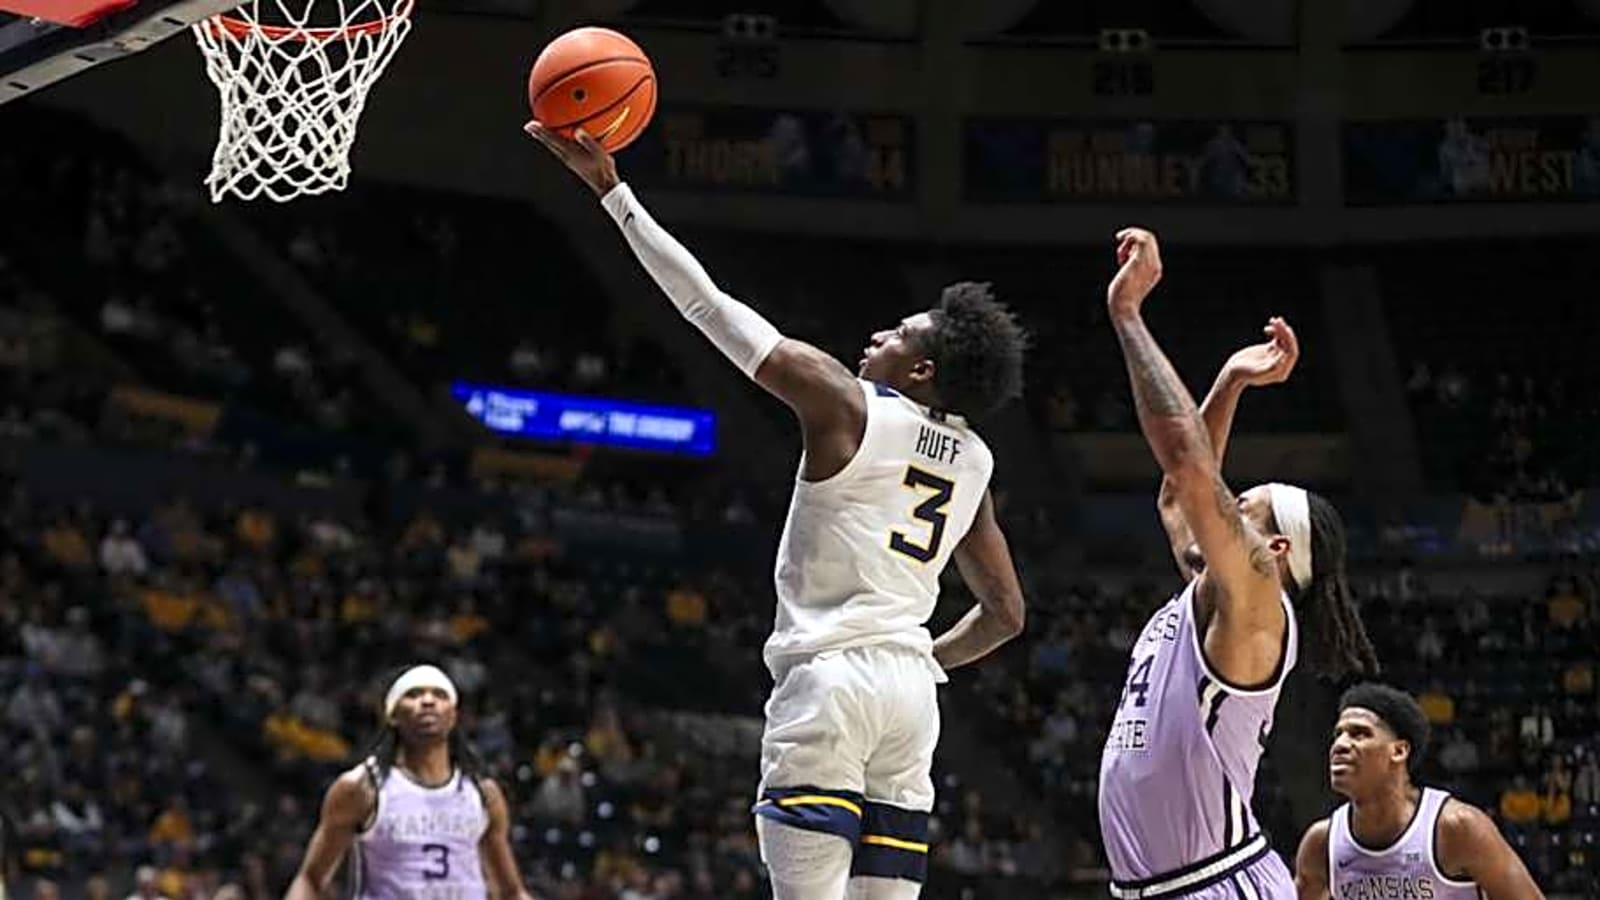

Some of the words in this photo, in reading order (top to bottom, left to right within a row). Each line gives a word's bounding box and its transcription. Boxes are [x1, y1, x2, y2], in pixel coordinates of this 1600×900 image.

[1477, 59, 1536, 95] 217
[1245, 154, 1287, 196] 33
[1488, 151, 1576, 193] WEST
[915, 423, 960, 465] HUFF
[888, 463, 956, 564] 3
[421, 843, 450, 881] 3
[1340, 876, 1434, 900] KANSAS
